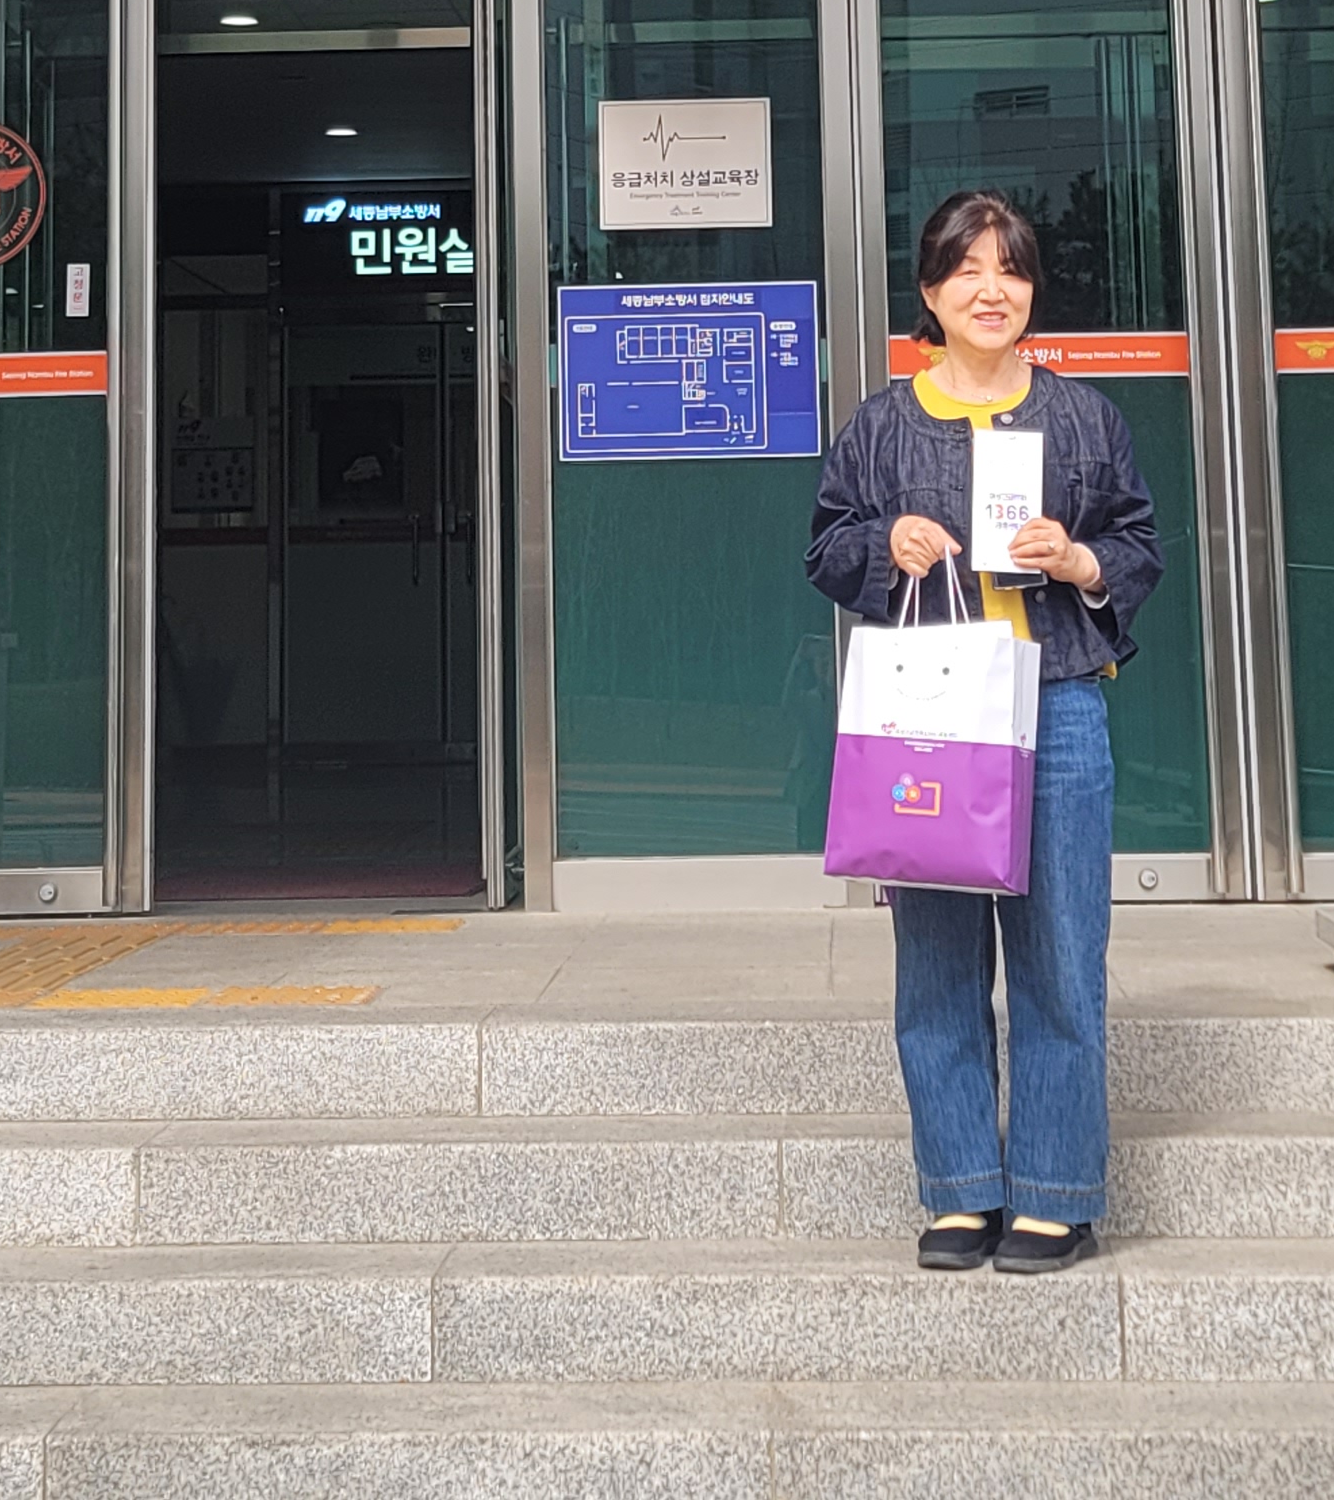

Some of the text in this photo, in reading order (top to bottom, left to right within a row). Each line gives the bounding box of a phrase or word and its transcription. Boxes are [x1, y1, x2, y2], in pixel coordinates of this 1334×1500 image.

[611, 168, 760, 188] 응급처치 상설교육장
[349, 203, 441, 221] 세종남부소방서
[0, 206, 33, 247] STATION
[621, 293, 697, 308] 세종남부소방서
[1015, 347, 1063, 364] 소방서
[985, 503, 1030, 521] 1366
